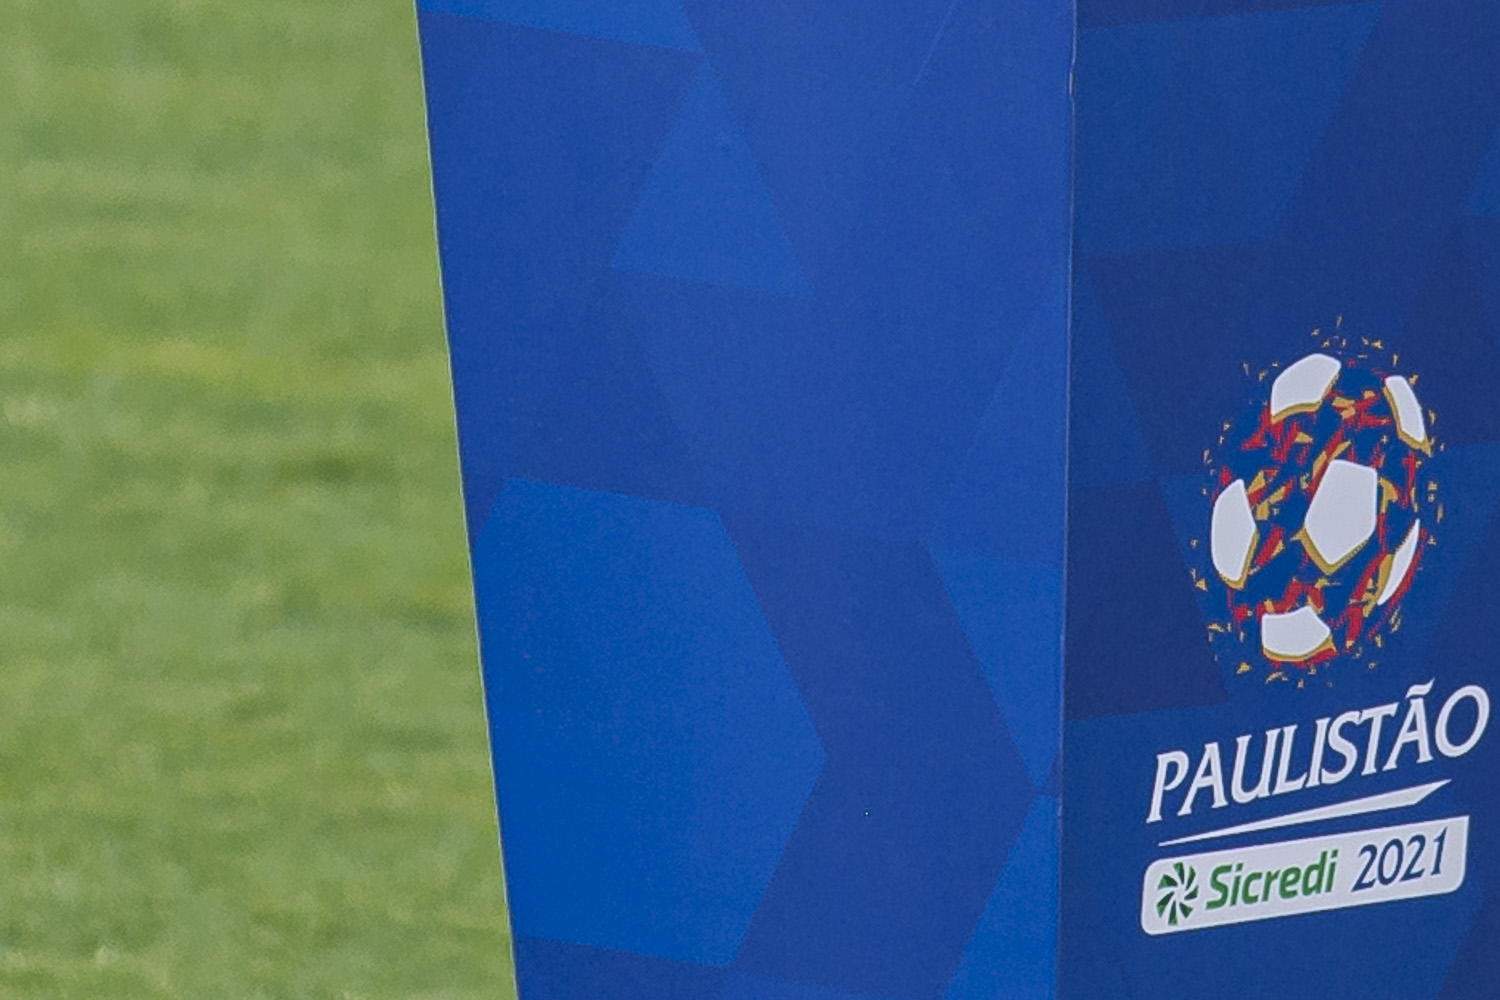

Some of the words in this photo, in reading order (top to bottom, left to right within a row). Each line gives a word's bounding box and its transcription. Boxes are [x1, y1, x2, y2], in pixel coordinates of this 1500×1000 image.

[1145, 677, 1491, 824] PAULISTÃO
[1205, 848, 1340, 911] Sicredi
[1351, 827, 1446, 894] 2021
